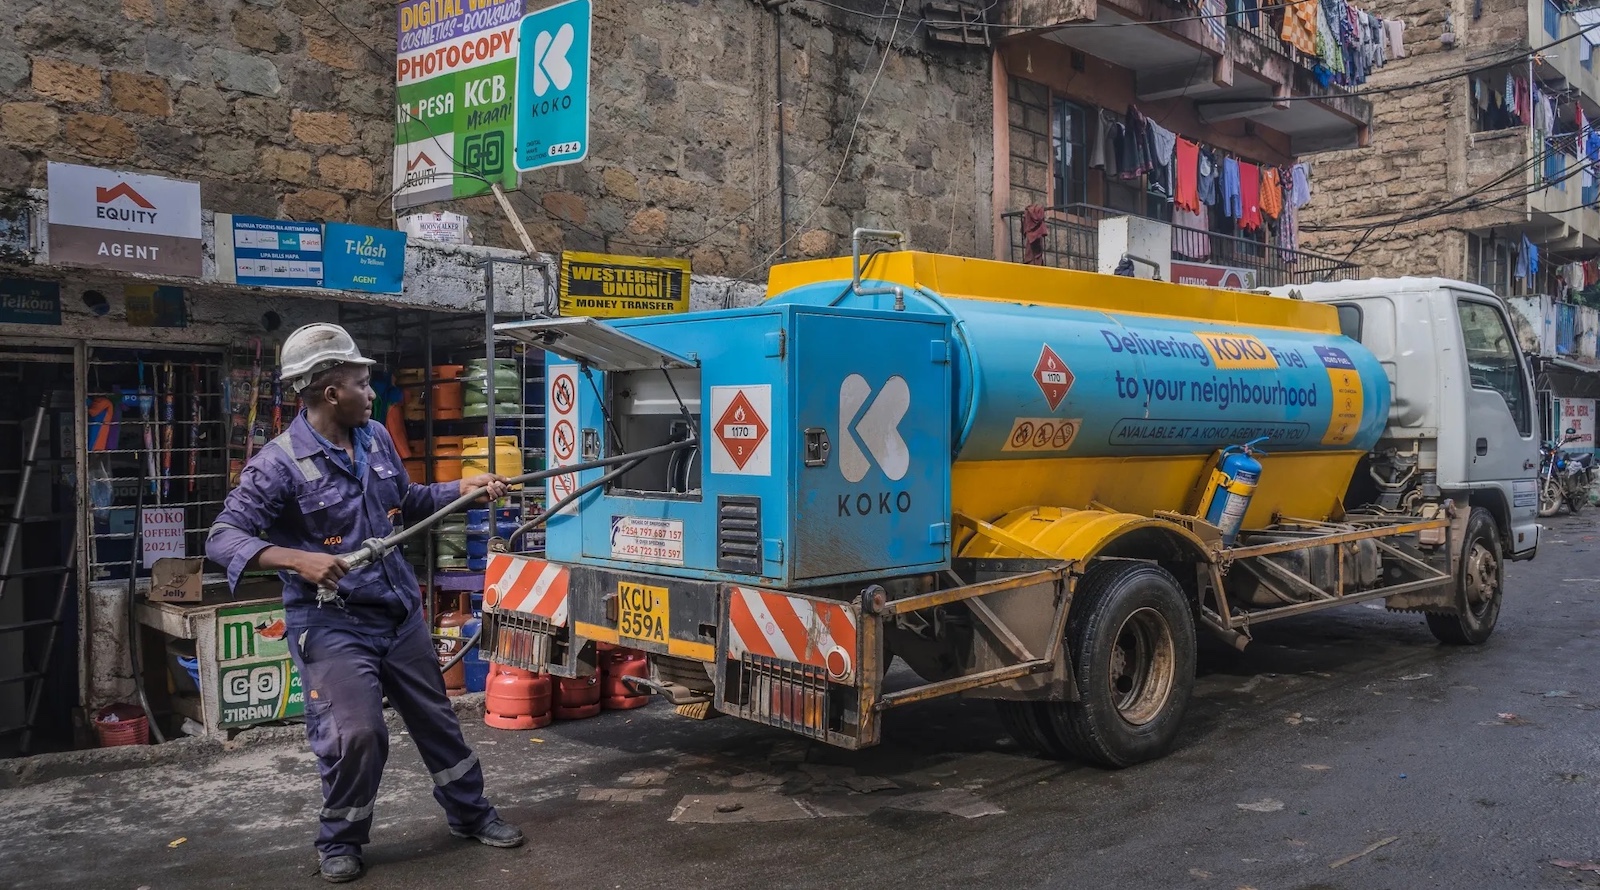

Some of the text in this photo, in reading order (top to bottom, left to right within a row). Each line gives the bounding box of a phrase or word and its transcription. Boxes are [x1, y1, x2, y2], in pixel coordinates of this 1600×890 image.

[398, 28, 515, 82] PHOTOCOPY
[464, 75, 506, 108] KCB
[467, 96, 512, 130] Mtaani
[532, 95, 571, 117] KOKO
[551, 143, 577, 155] 8424
[407, 167, 436, 188] EQUITY
[96, 206, 158, 225] EQUITY
[97, 241, 159, 260] AGENT
[345, 239, 387, 259] T-kash
[353, 276, 377, 285] AGENT
[572, 266, 658, 284] WESTERN
[602, 283, 658, 298] UNION
[1, 294, 54, 310] Telkom
[576, 299, 674, 311] MONEY TRANSFER
[1101, 330, 1307, 369] Delivering KOKO Fuel
[1047, 373, 1061, 382] 1170
[1115, 370, 1317, 410] to your neighbourhood
[731, 426, 749, 437] 1170
[1118, 425, 1176, 439] AVAILABLE
[1175, 427, 1191, 439] AT
[1191, 427, 1202, 439] A
[1201, 427, 1230, 440] KOKO
[1229, 428, 1262, 440] AGENT
[737, 445, 743, 456] 3
[838, 491, 911, 517] KOKO
[144, 512, 184, 524] KOKO
[639, 528, 652, 537] 797
[669, 531, 682, 540] 157
[144, 541, 186, 552] 2021/=
[640, 547, 653, 556] 722
[668, 550, 681, 559] 597
[163, 589, 187, 599] Jelly
[620, 586, 652, 613] KCU
[621, 610, 665, 641] 559A
[224, 704, 273, 723] JIRANI
